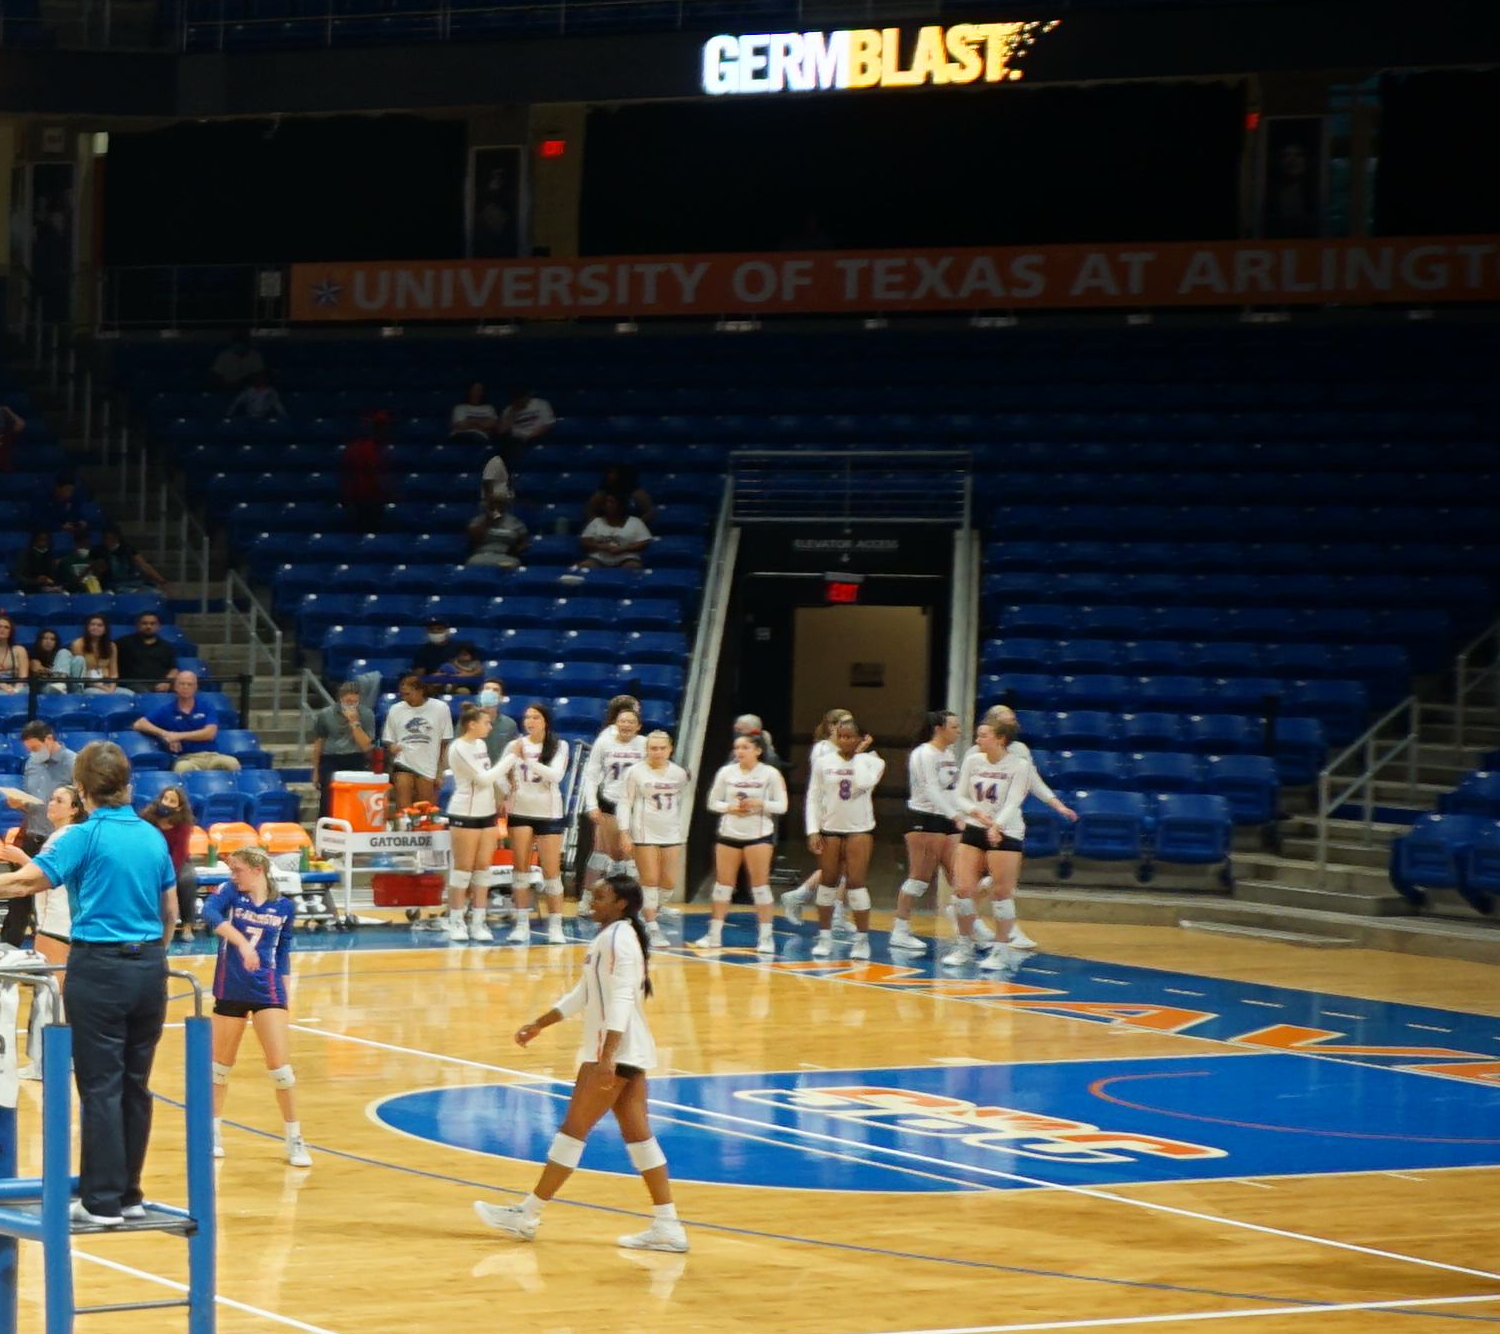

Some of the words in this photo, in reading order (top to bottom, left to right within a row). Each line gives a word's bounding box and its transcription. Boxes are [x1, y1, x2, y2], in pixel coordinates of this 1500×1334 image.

[702, 21, 1030, 95] GERMBLAST
[352, 261, 710, 311] UNIVERSITY
[731, 259, 816, 304] OF
[834, 253, 1046, 302] TEXAS
[1072, 250, 1155, 296] AT
[1177, 241, 1500, 294] ARLINGT
[839, 780, 851, 800] 8
[973, 782, 999, 804] 14
[370, 836, 433, 849] GATORADE
[246, 927, 264, 948] 7
